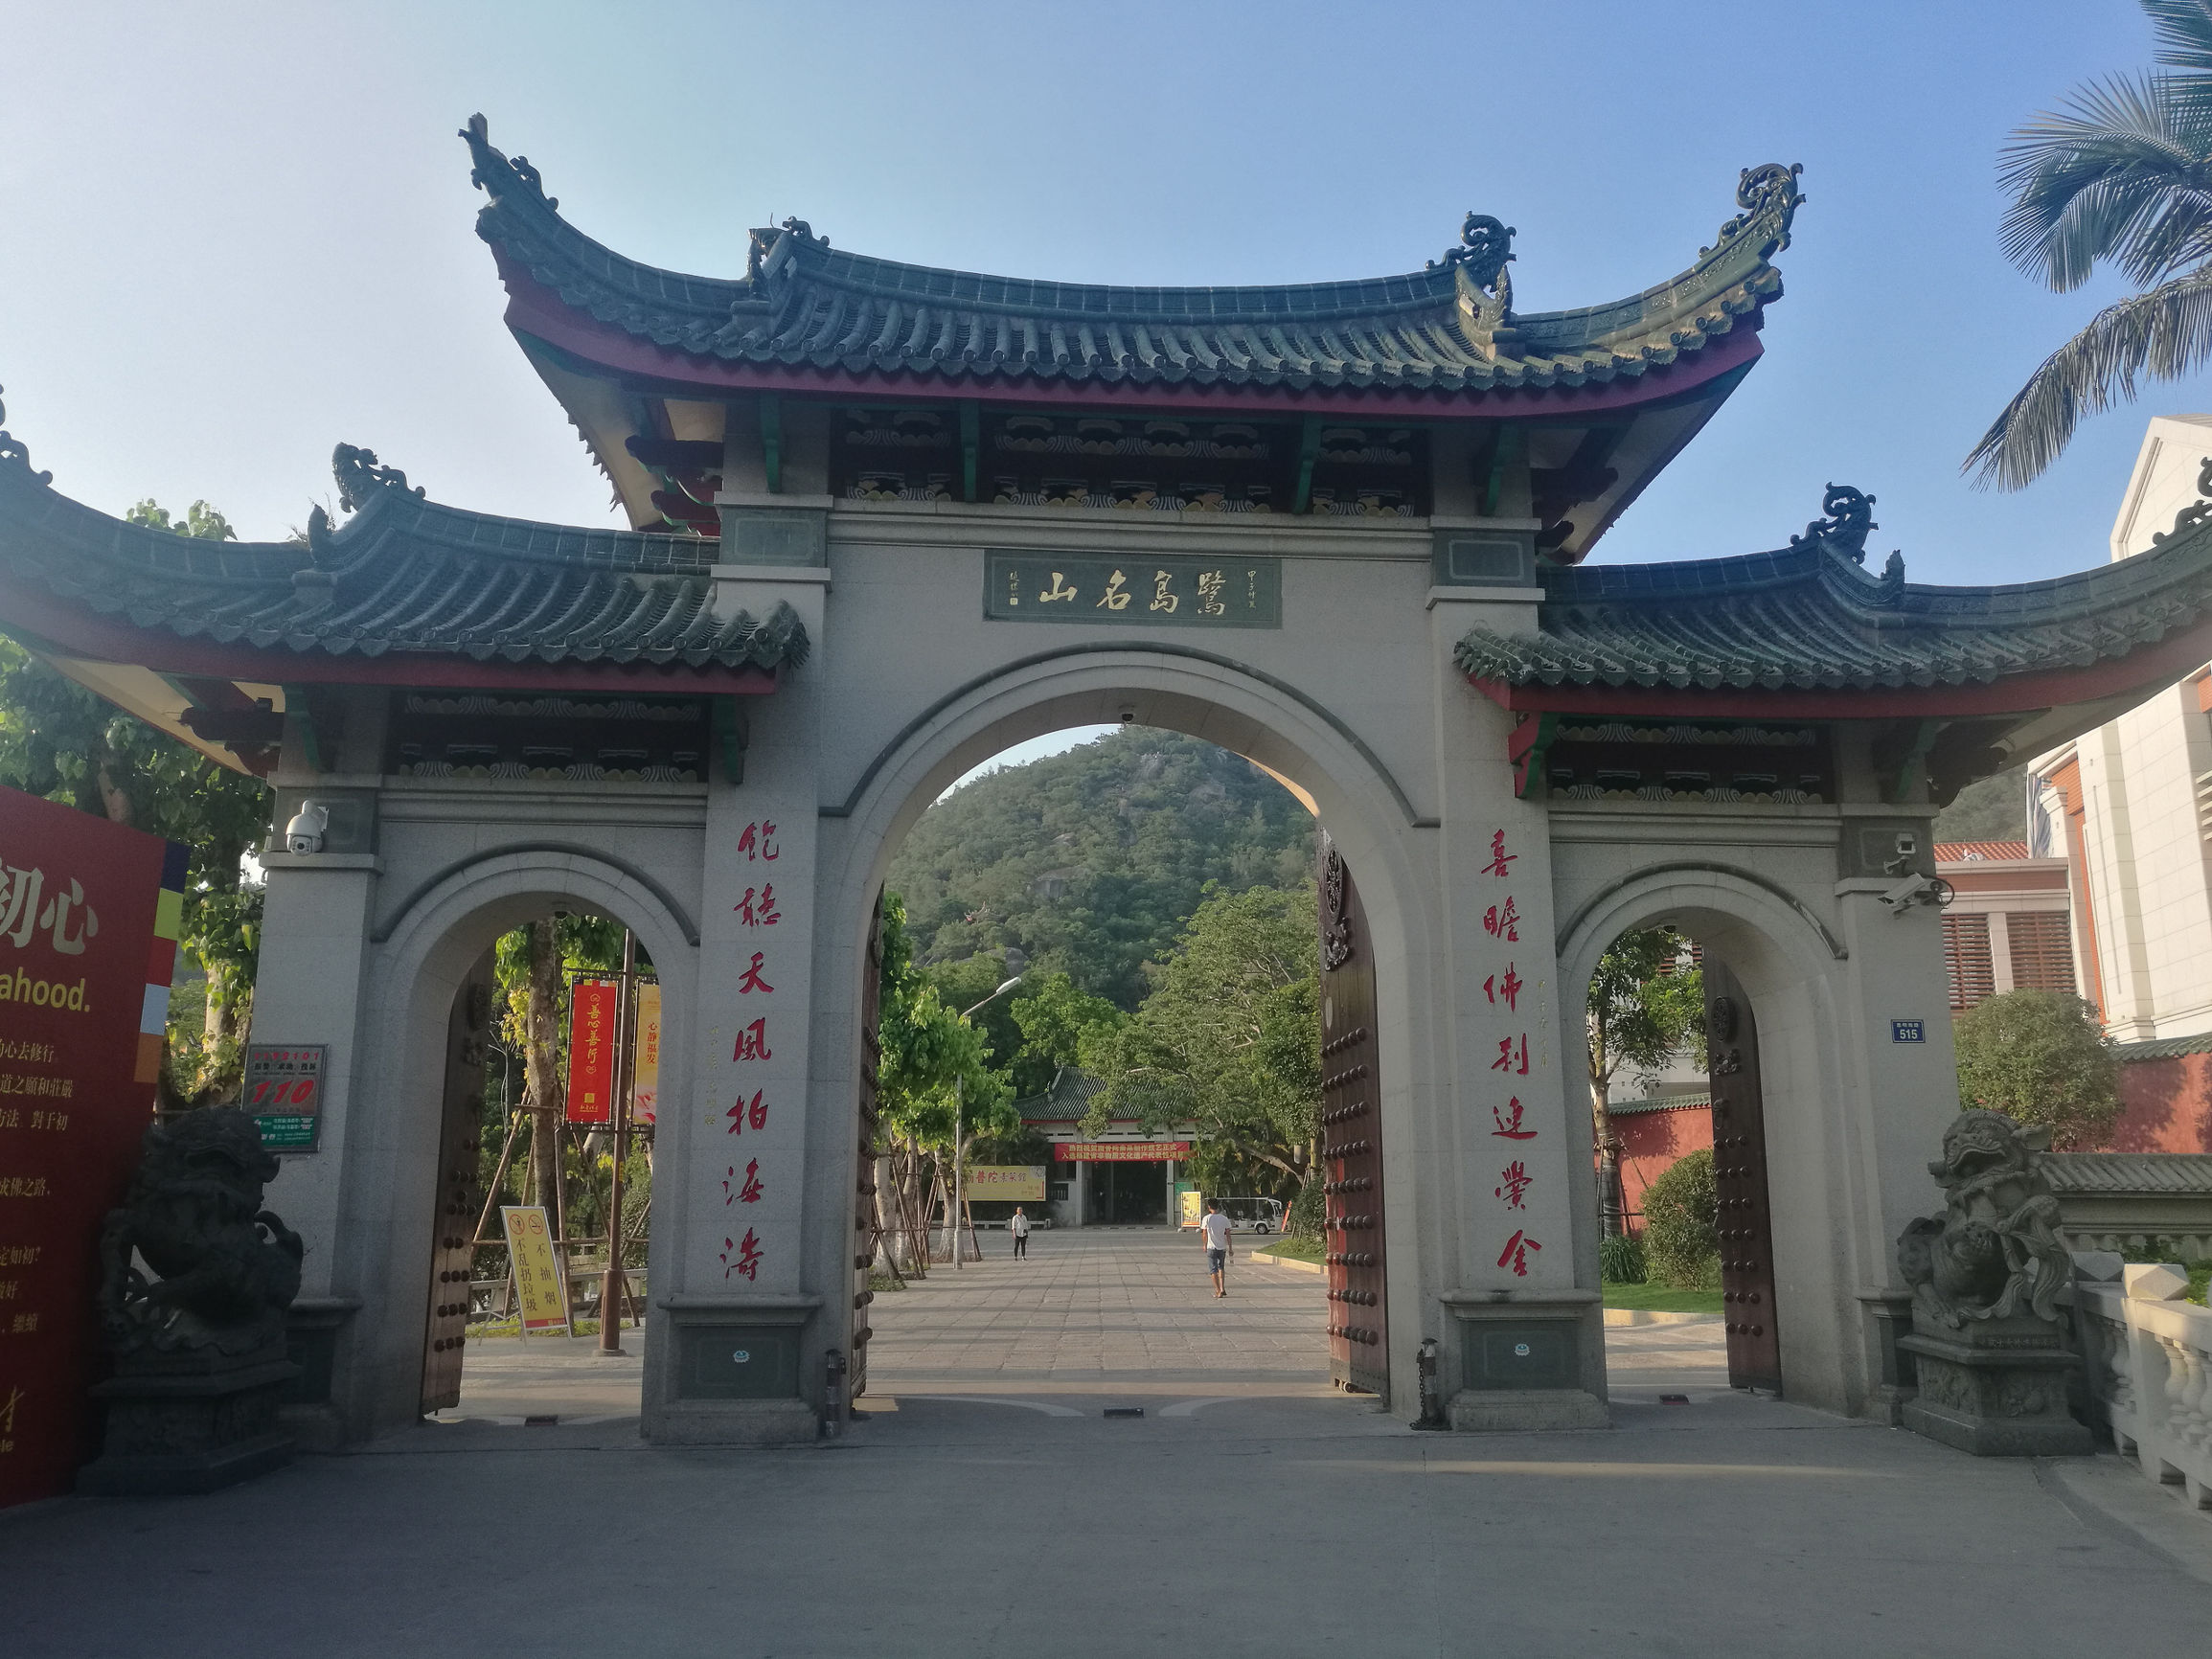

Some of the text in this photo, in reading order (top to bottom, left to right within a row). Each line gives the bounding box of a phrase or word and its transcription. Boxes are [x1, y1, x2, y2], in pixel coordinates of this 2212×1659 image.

[1900, 1029, 1918, 1039] 515
[252, 1079, 315, 1104] 110
[515, 1238, 538, 1312] 不乱扔垃圾
[536, 1244, 556, 1307] 不抽烟
